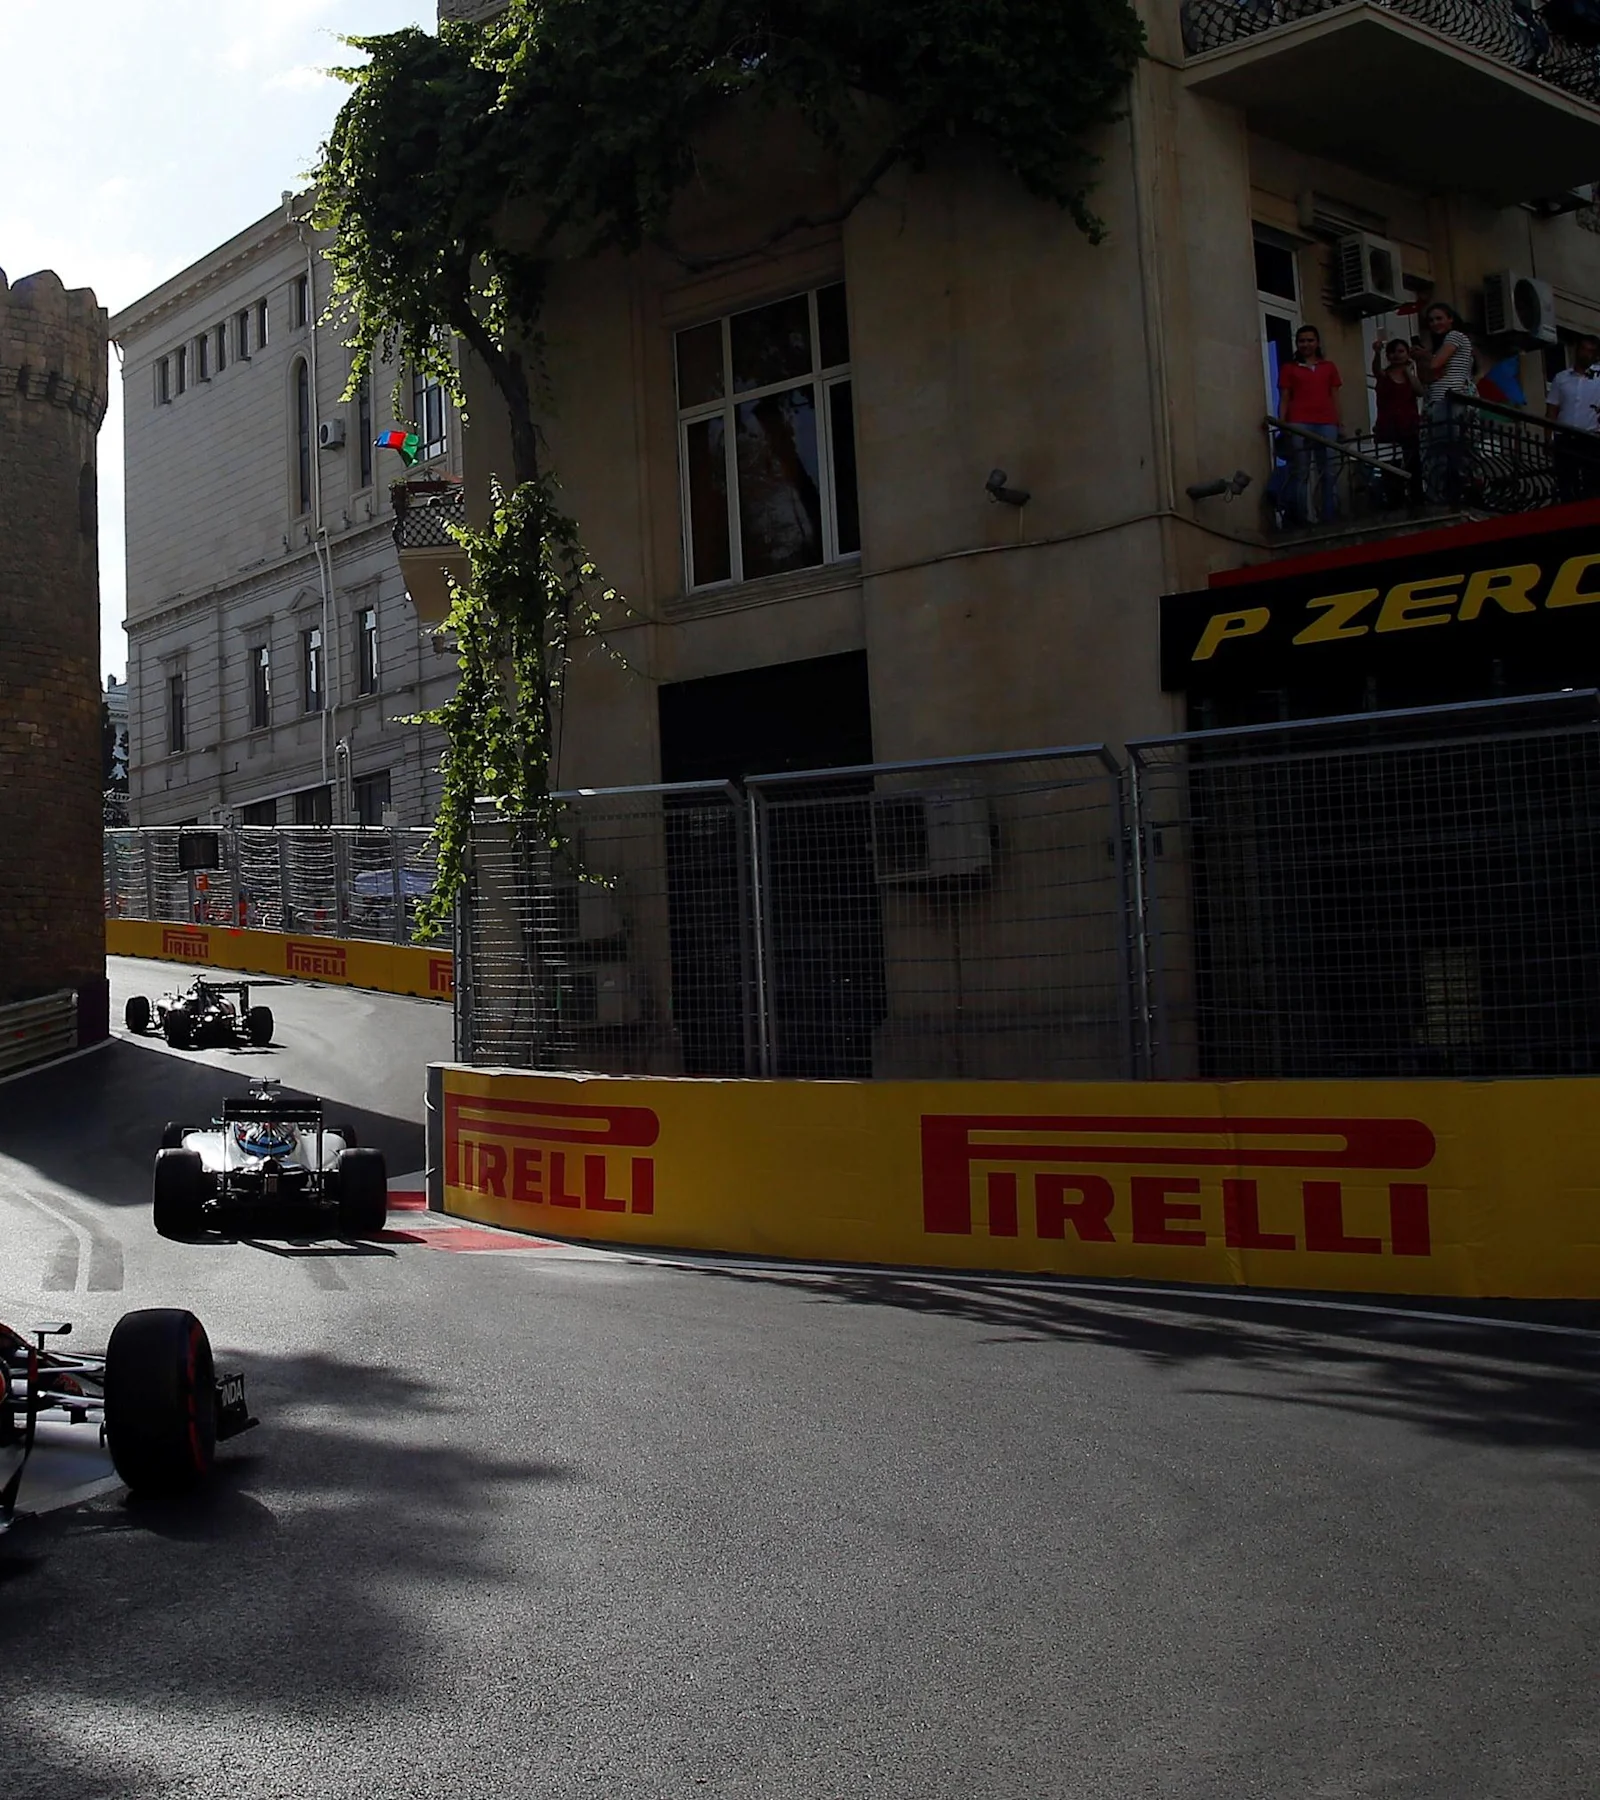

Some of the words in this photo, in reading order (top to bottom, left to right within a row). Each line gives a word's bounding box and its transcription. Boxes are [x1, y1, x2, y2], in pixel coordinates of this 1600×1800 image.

[1191, 607, 1271, 661] P
[162, 929, 209, 959] PIRELLI
[287, 942, 346, 977] PIRELLI
[445, 1092, 659, 1214] PIRELLI
[921, 1115, 1436, 1256] PIRELLI
